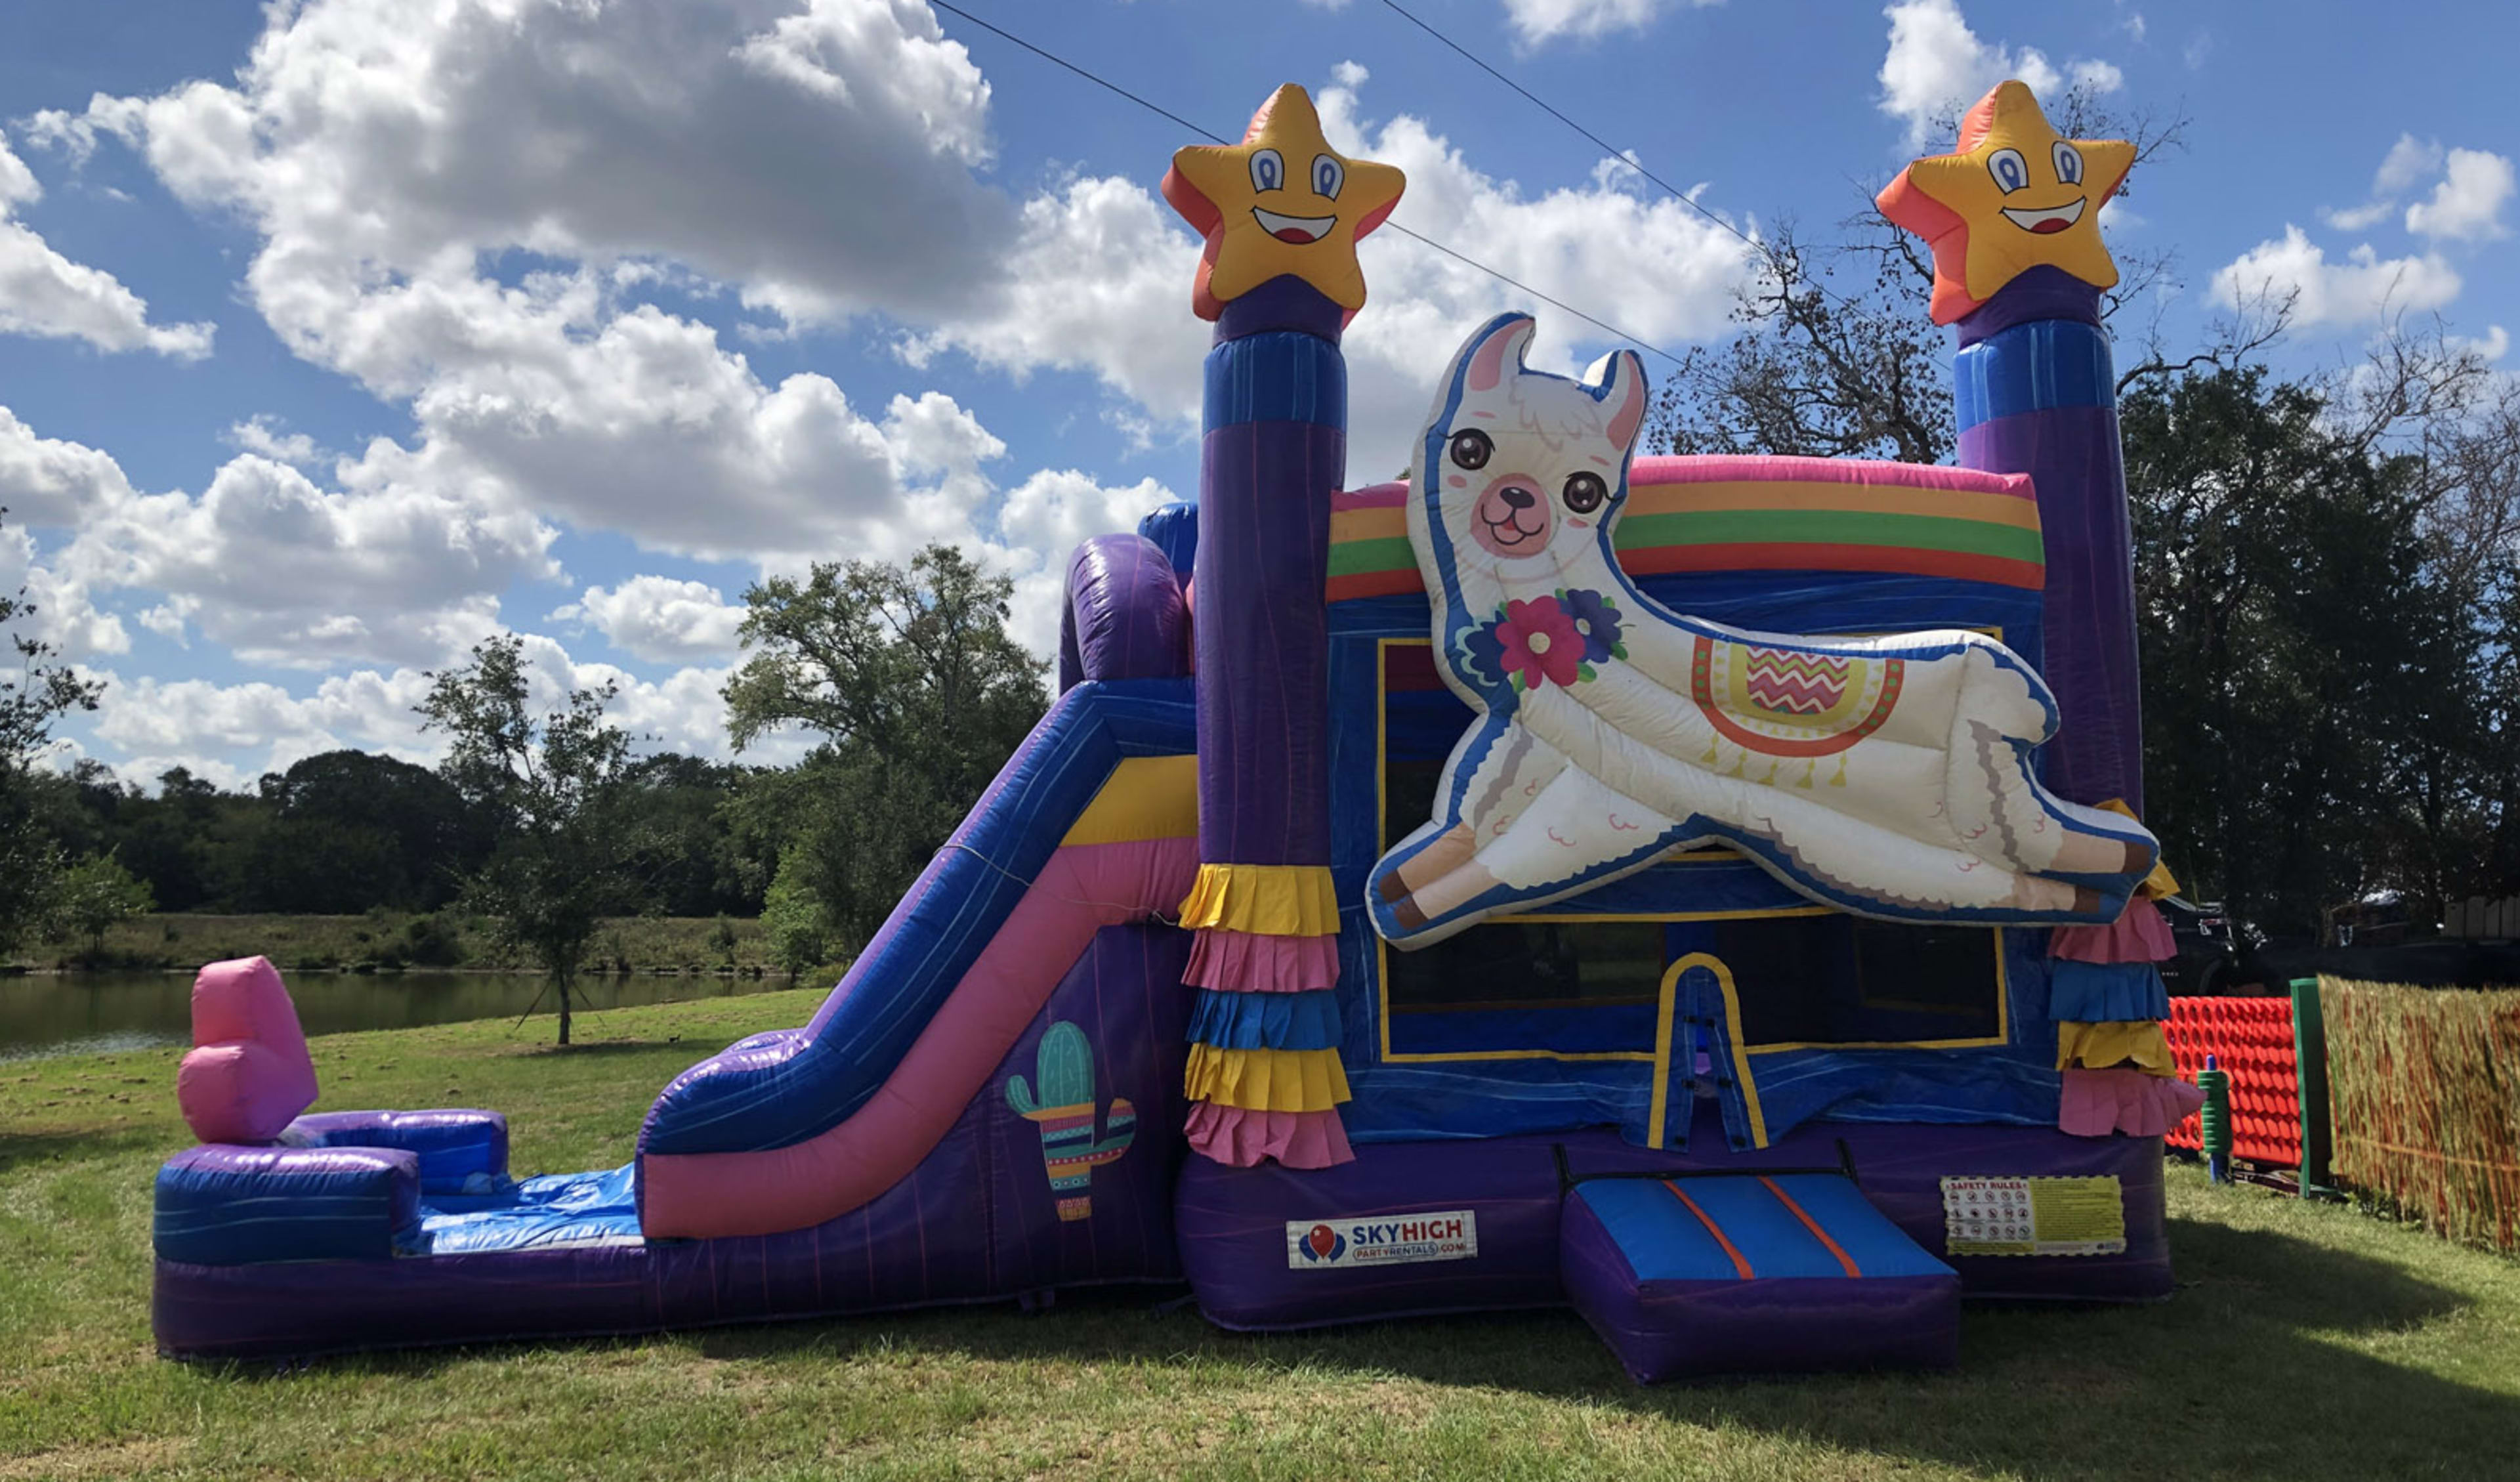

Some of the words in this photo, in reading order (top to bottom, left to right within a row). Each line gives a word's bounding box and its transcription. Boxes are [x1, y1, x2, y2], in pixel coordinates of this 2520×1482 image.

[1950, 1181, 1986, 1190] SAFETY
[1989, 1181, 2022, 1190] RULES
[1353, 1219, 1462, 1245] SKYHIGH
